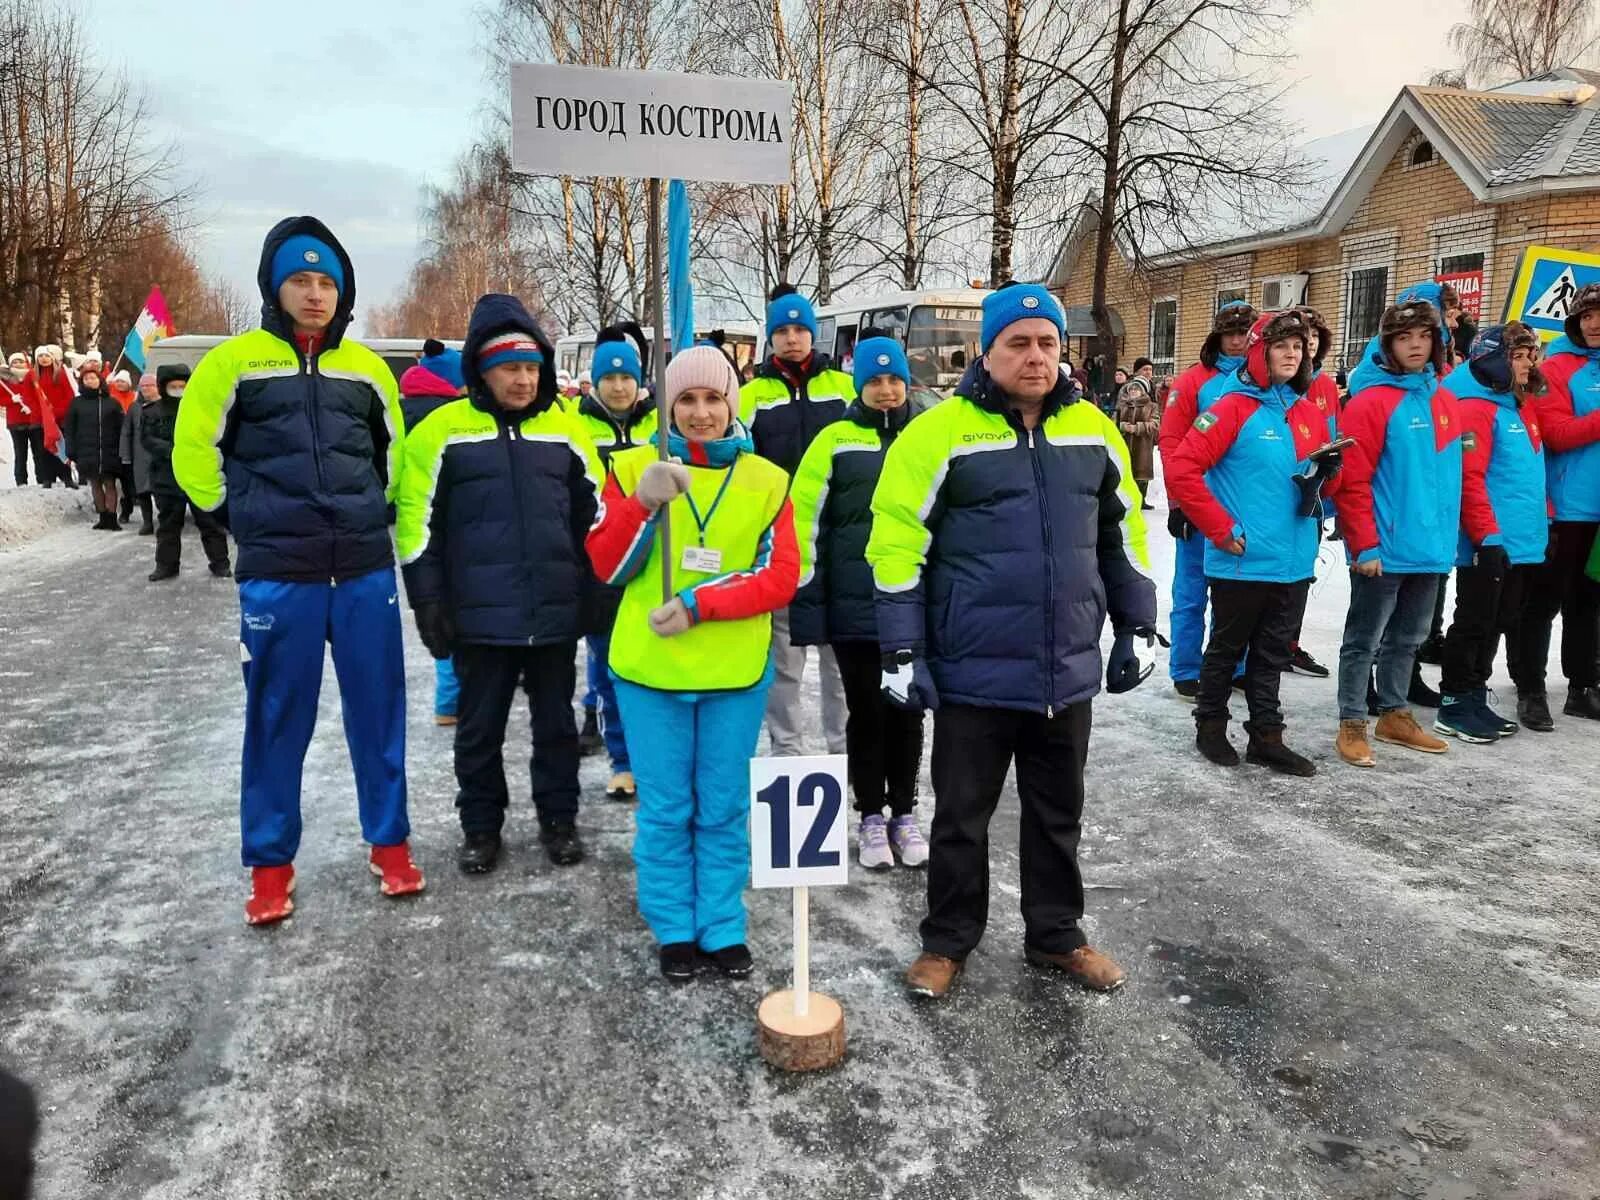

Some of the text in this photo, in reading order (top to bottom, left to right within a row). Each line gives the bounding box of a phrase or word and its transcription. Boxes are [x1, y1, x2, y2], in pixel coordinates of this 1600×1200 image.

[535, 96, 783, 143] ГОРОД КОСТРОМА
[248, 360, 293, 368] GIVOVA
[962, 430, 1013, 442] GIVOVA
[756, 772, 842, 869] 12
